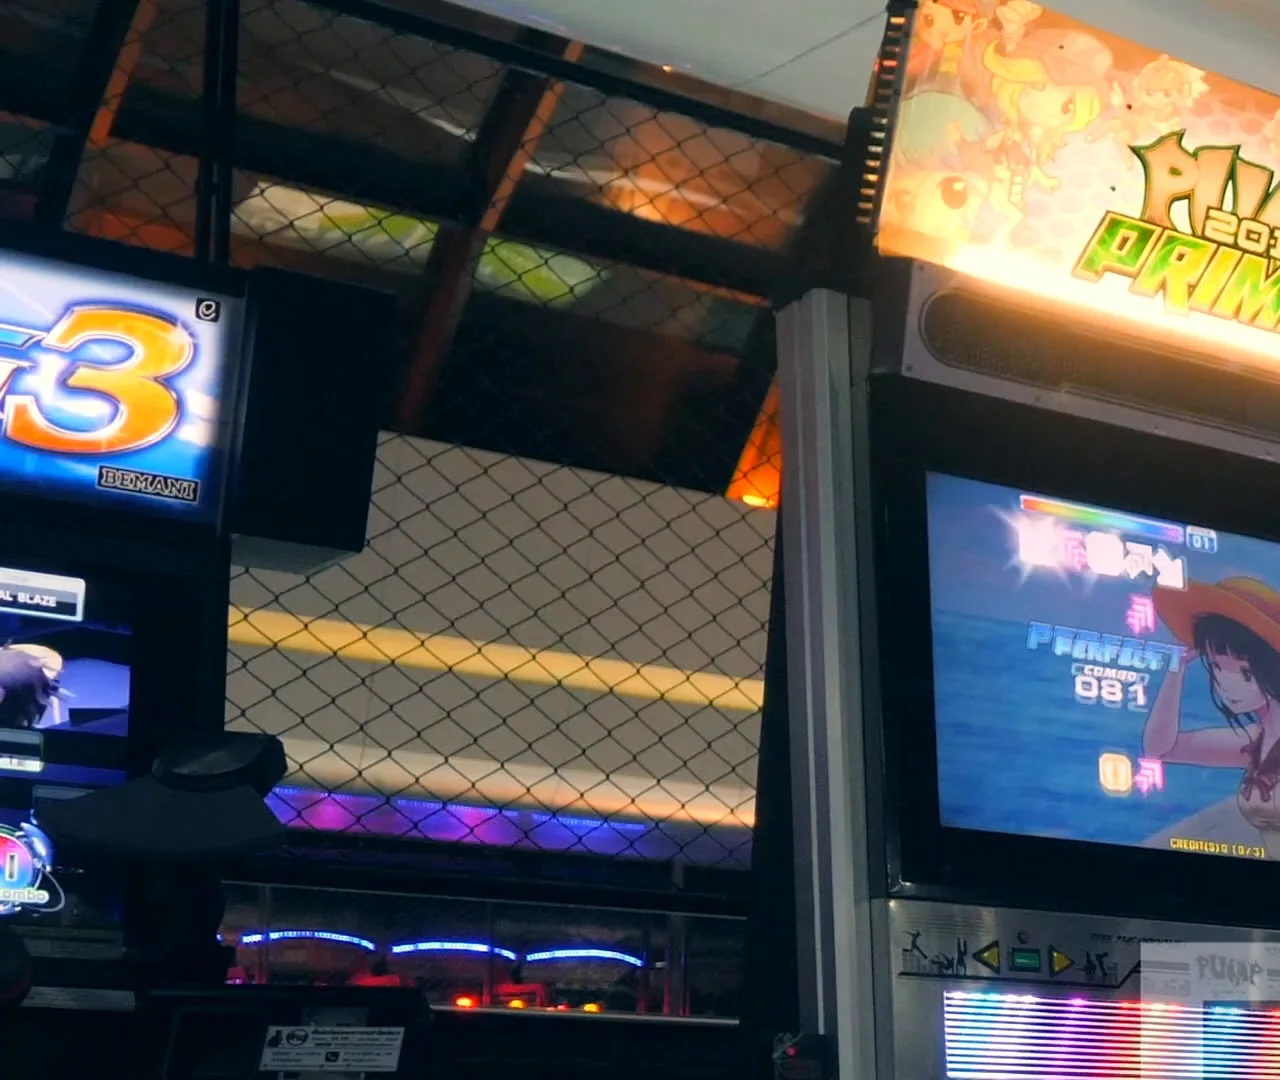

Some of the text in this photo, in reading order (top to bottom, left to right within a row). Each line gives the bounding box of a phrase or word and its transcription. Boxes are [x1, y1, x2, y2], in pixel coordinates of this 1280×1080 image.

[4, 304, 197, 455] 3
[101, 467, 196, 500] BEMANI
[1192, 535, 1209, 550] 01
[17, 592, 57, 607] BLAZE
[1026, 621, 1187, 673] PERFECT
[1077, 663, 1143, 684] COMBO
[1075, 675, 1149, 708] 081
